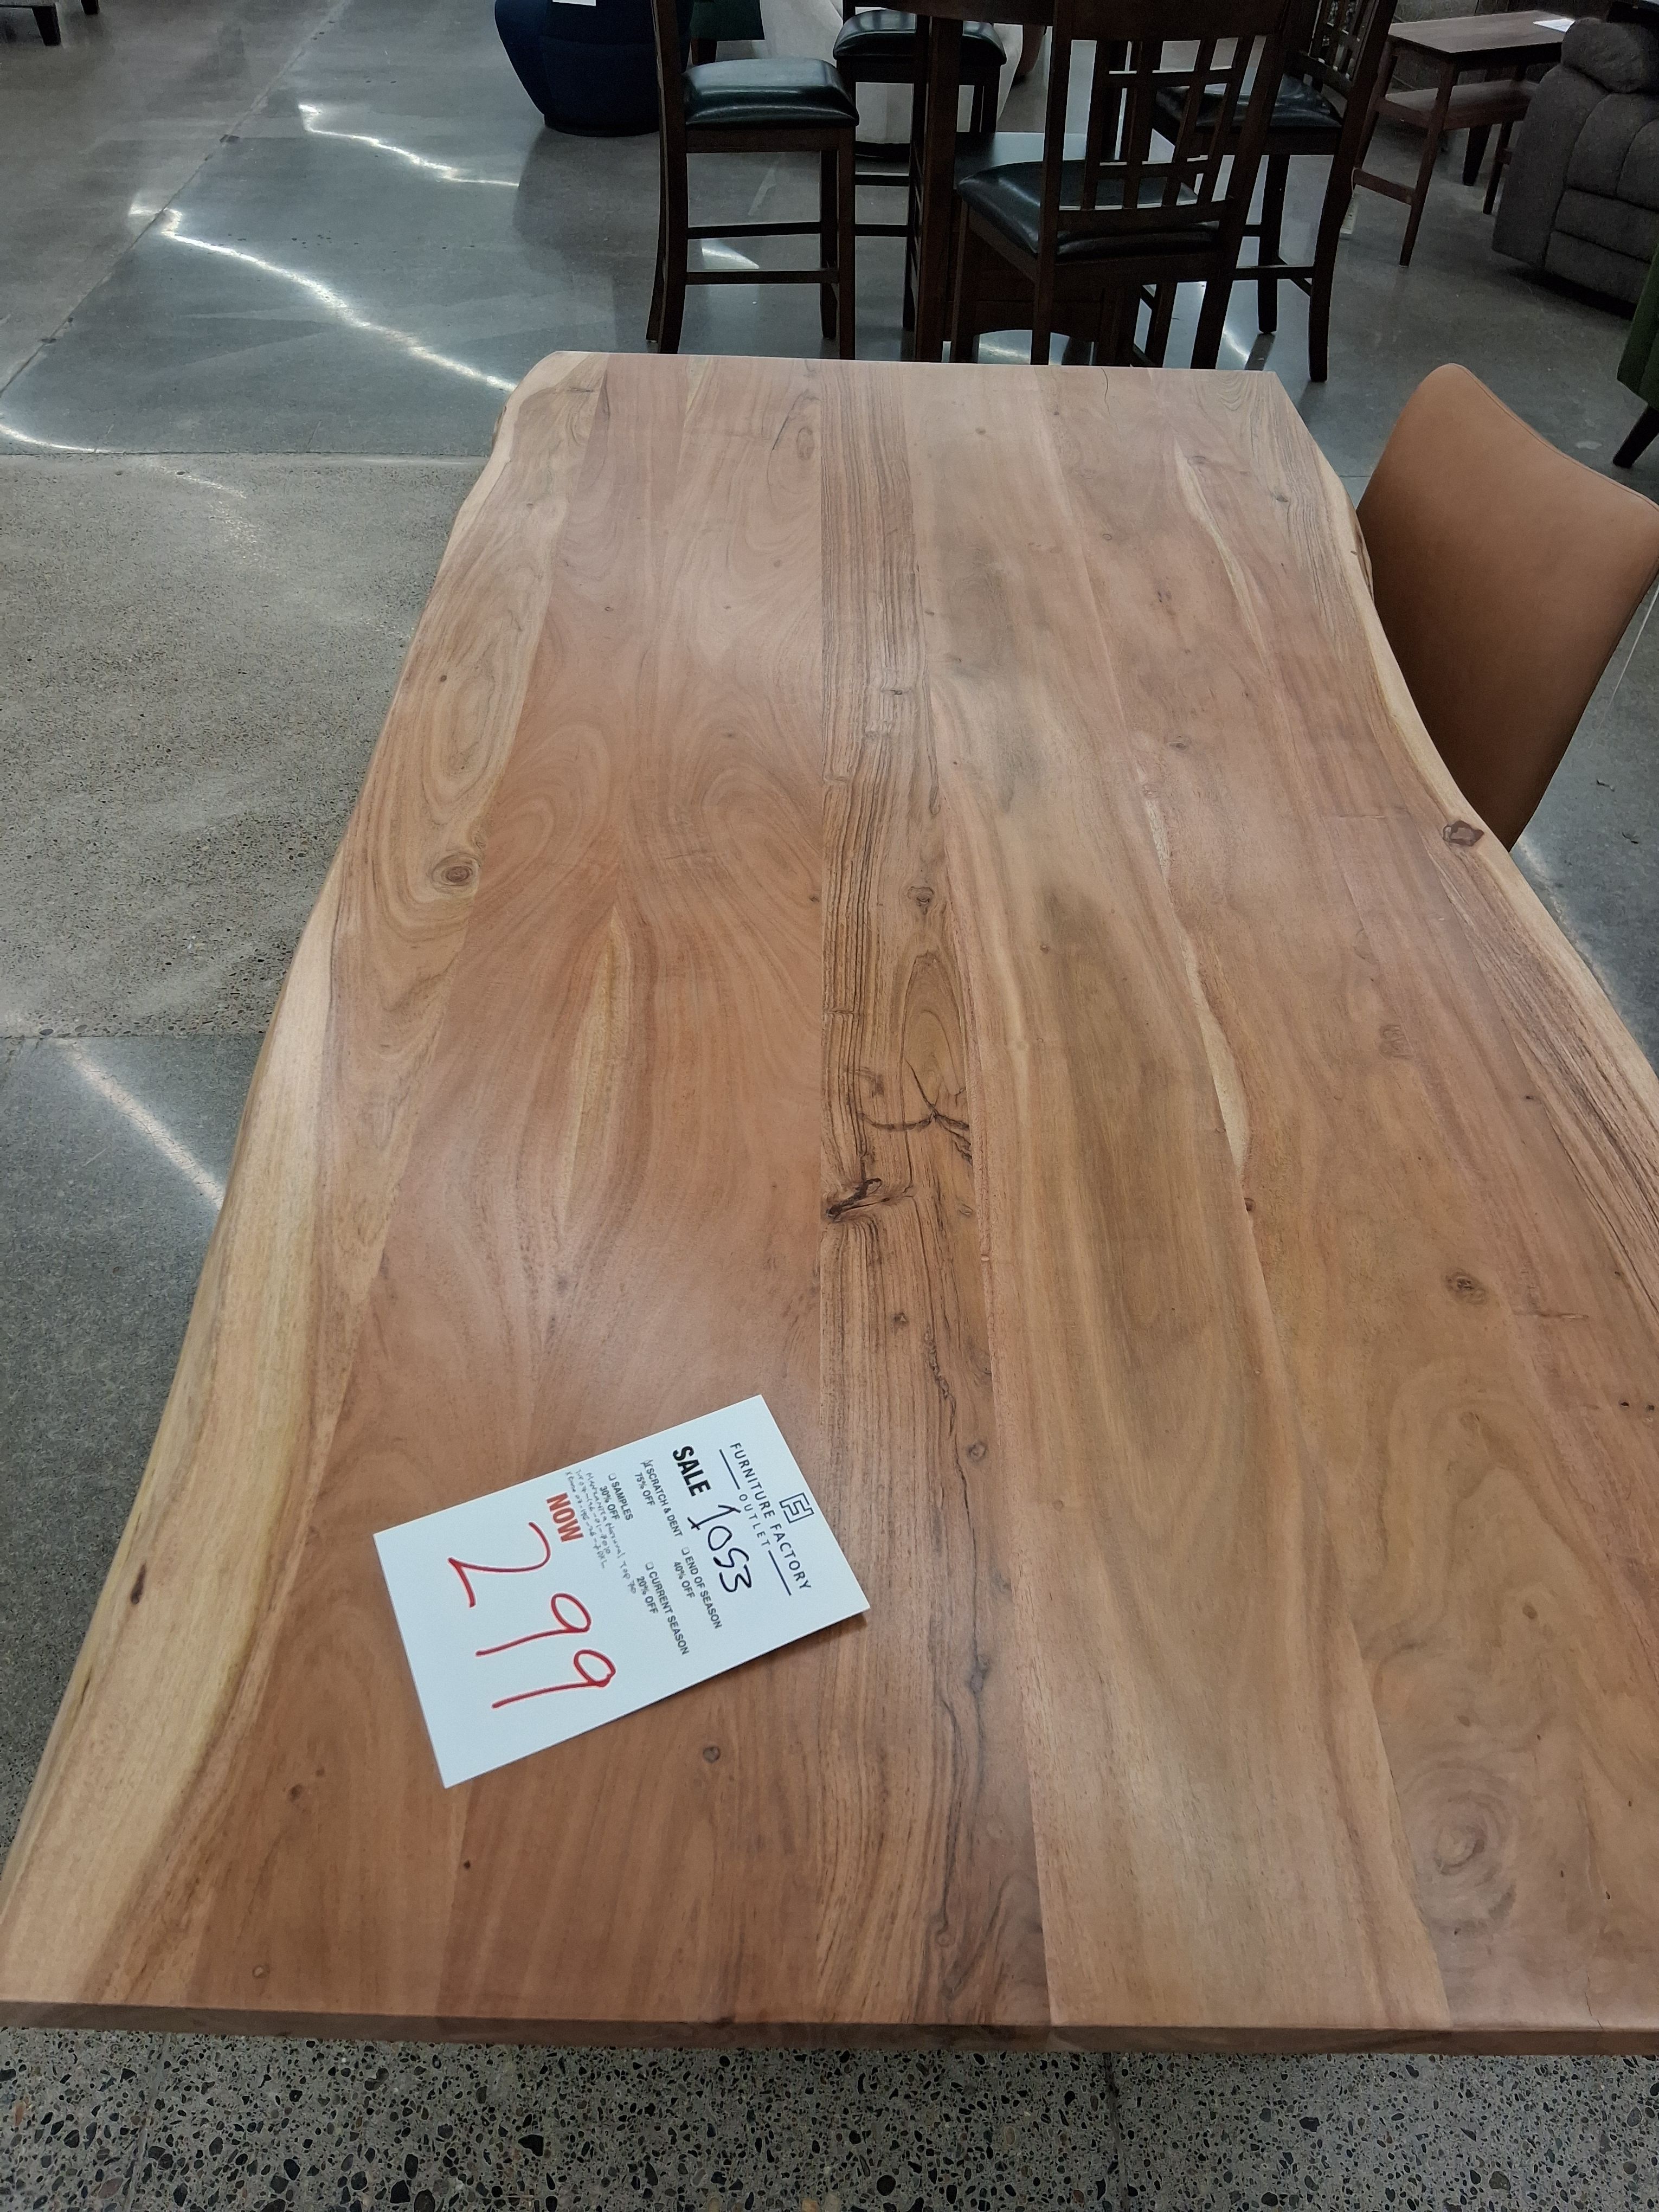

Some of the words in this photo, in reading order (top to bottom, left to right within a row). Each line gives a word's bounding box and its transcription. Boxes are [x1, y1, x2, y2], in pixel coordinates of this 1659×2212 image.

[634, 1471, 647, 1489] 75%
[642, 1490, 655, 1506] OFF
[672, 1445, 712, 1497] SALE
[546, 1492, 584, 1542] NOW
[599, 1485, 612, 1503] 30%
[607, 1503, 620, 1520] OFF
[611, 1481, 634, 1521] SAMPLES
[646, 1468, 669, 1507] SCRATCH
[666, 1514, 683, 1536] DENT
[730, 1442, 776, 1519] FURNITURE
[769, 1523, 812, 1589] FACTORY
[738, 1494, 771, 1546] OUTLET
[636, 1576, 650, 1596] 20%
[645, 1596, 659, 1613] OFF
[673, 1561, 686, 1580] 40%
[681, 1580, 696, 1598] OFF
[685, 1555, 699, 1576] END
[694, 1576, 706, 1589] OF
[700, 1590, 723, 1629] SEASON
[448, 1521, 616, 1709] 299
[648, 1571, 673, 1614] CURRENT
[667, 1615, 690, 1655] SEASON
